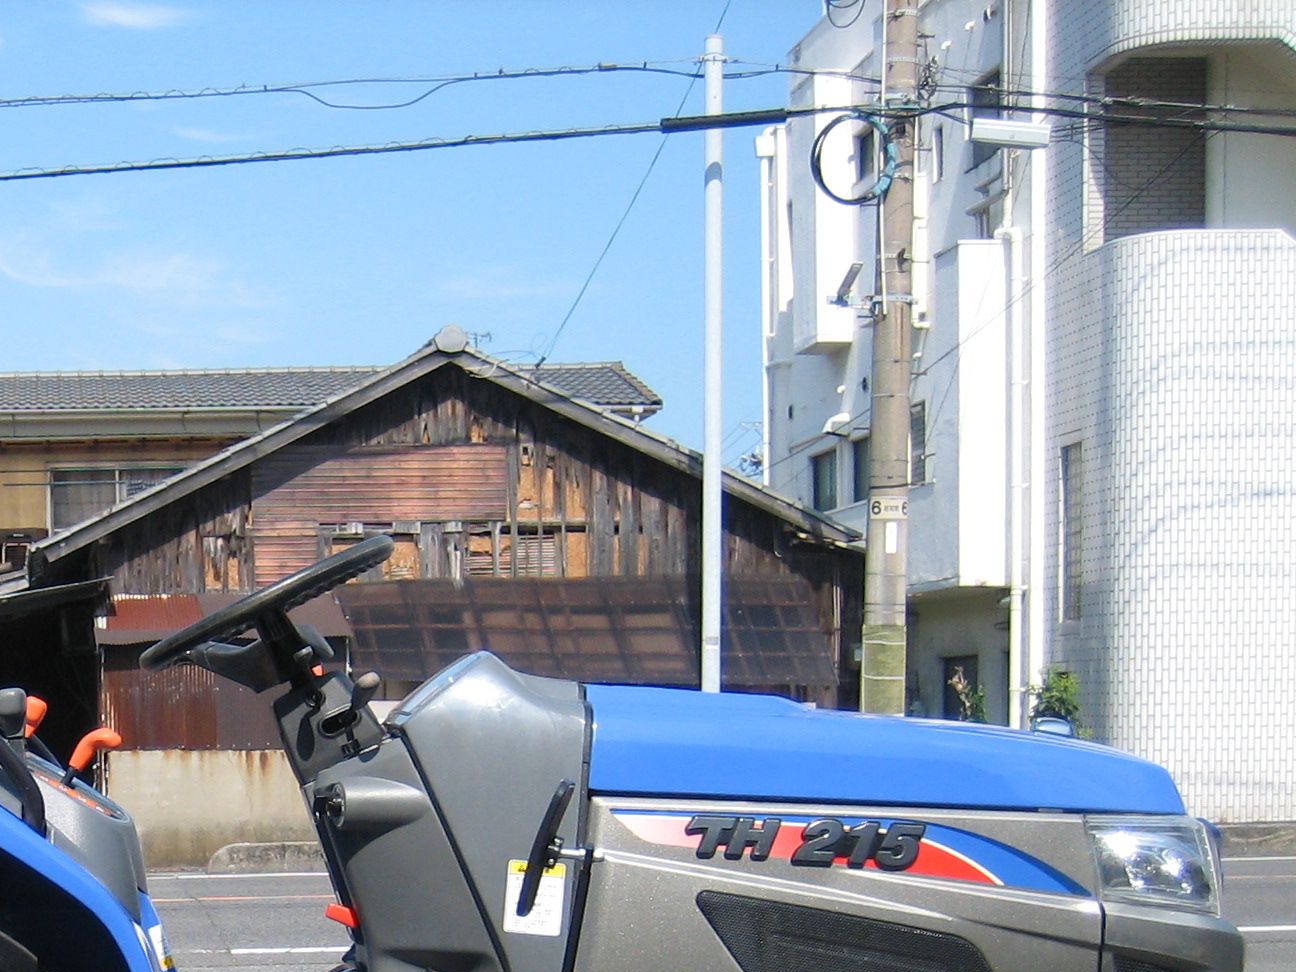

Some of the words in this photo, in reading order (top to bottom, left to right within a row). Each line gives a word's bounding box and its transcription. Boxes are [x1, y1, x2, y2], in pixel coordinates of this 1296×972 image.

[871, 501, 882, 516] 6
[685, 815, 781, 861] TH
[790, 818, 926, 872] 215
